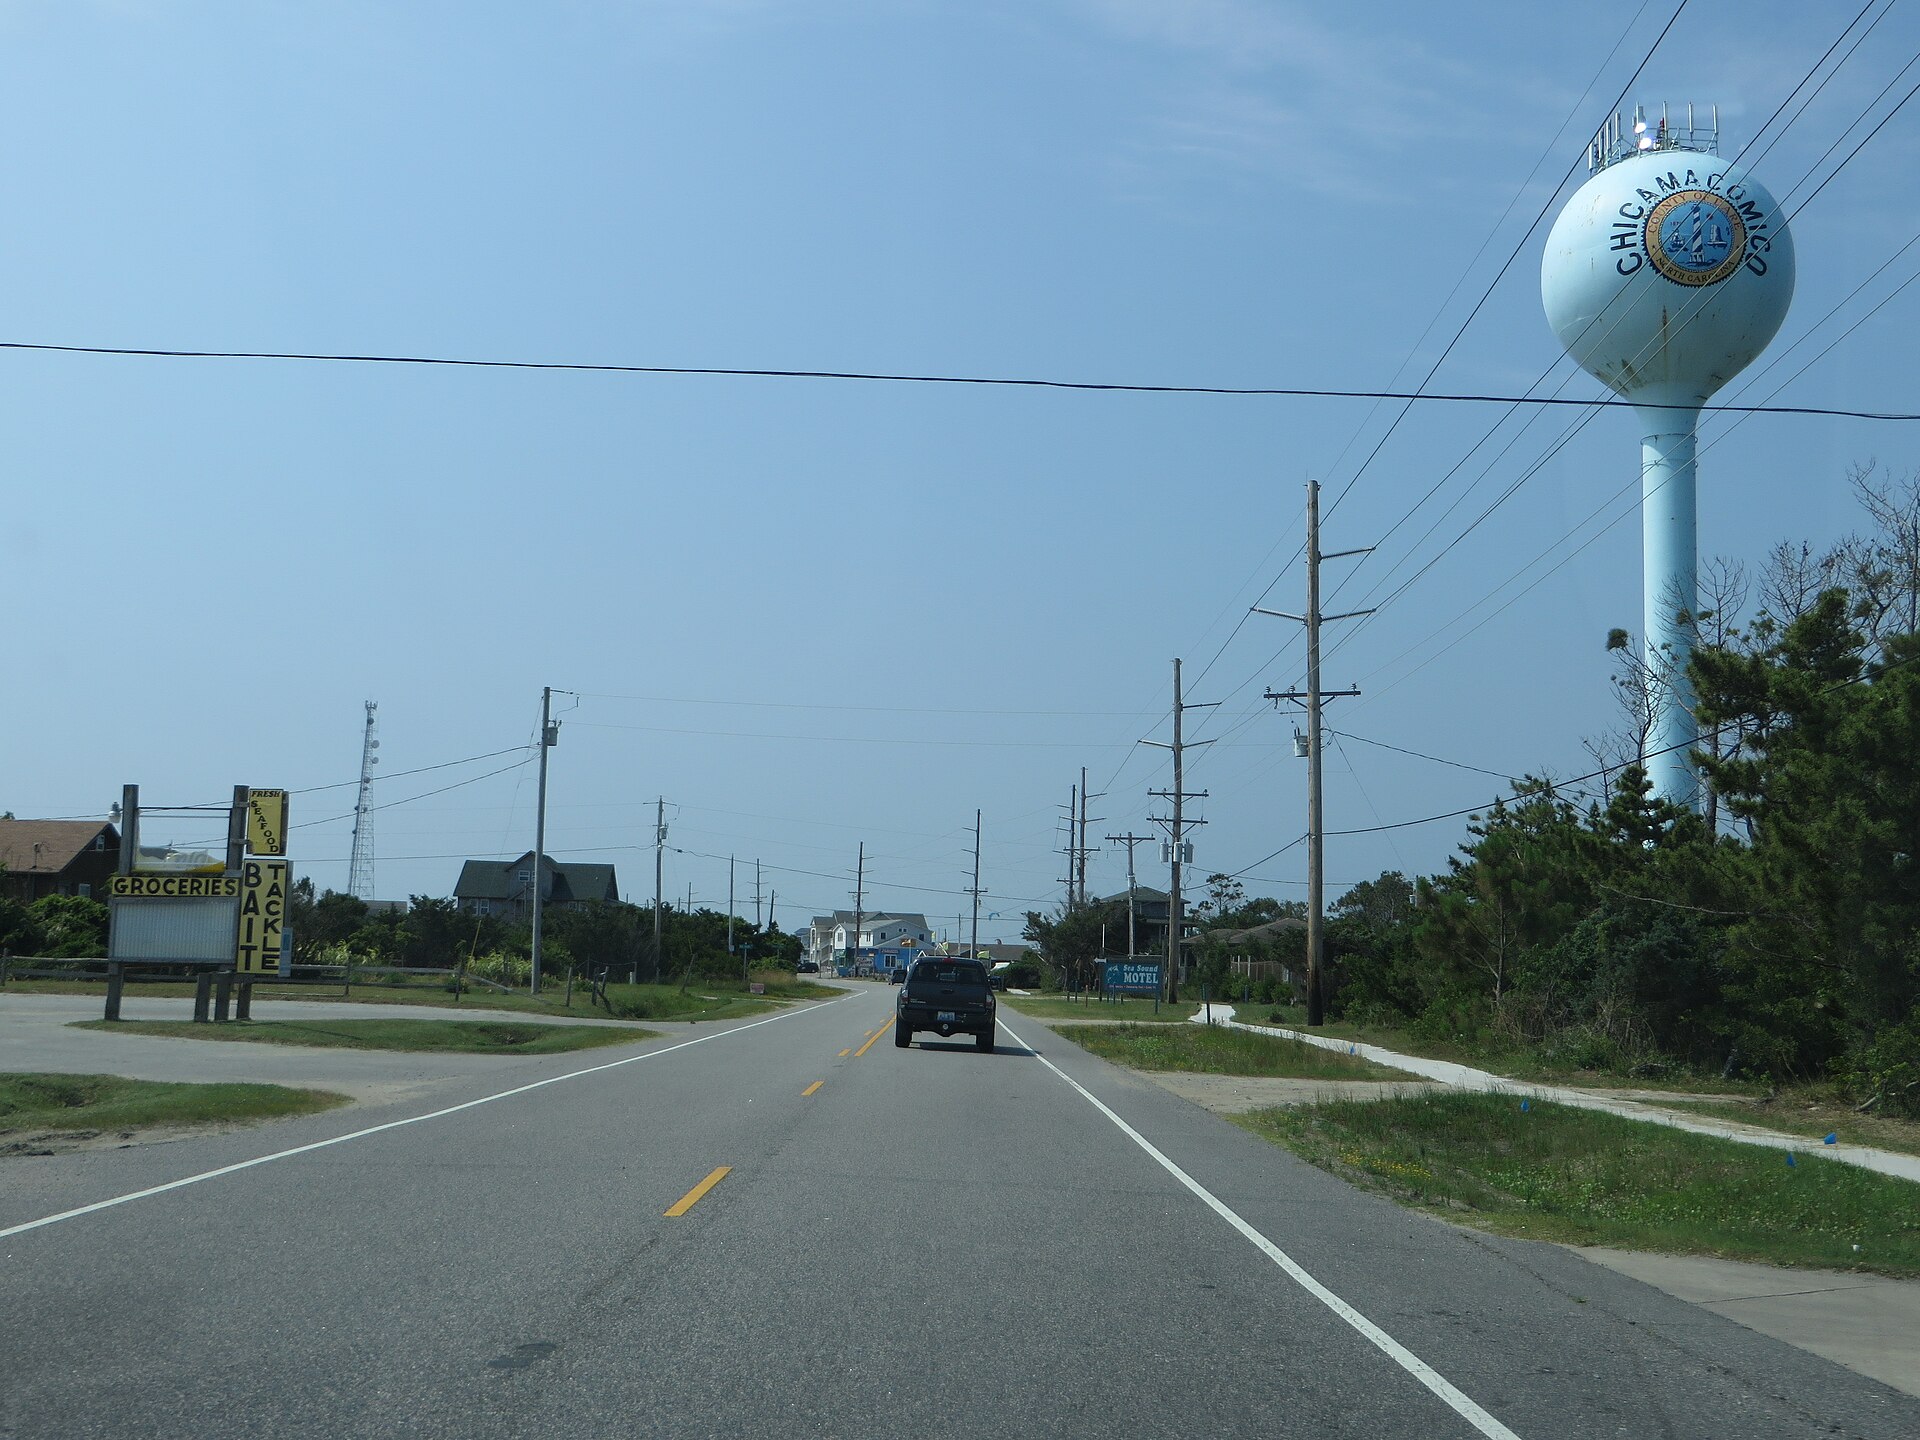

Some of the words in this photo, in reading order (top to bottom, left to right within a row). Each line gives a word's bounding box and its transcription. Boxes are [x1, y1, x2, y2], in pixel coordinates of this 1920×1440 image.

[1610, 169, 1770, 276] CHICAMACOMICO
[1648, 193, 1686, 233] COUNTY
[1713, 198, 1742, 230] DARE
[1656, 257, 1685, 280] NORTH
[251, 790, 281, 798] FRESH
[250, 800, 279, 853] SEAFOOD
[114, 878, 236, 895] GROCERIES
[240, 862, 262, 971] BAIT
[261, 864, 286, 970] TACKLE
[1124, 972, 1158, 984] MOTEL
[1136, 964, 1158, 972] Sound
